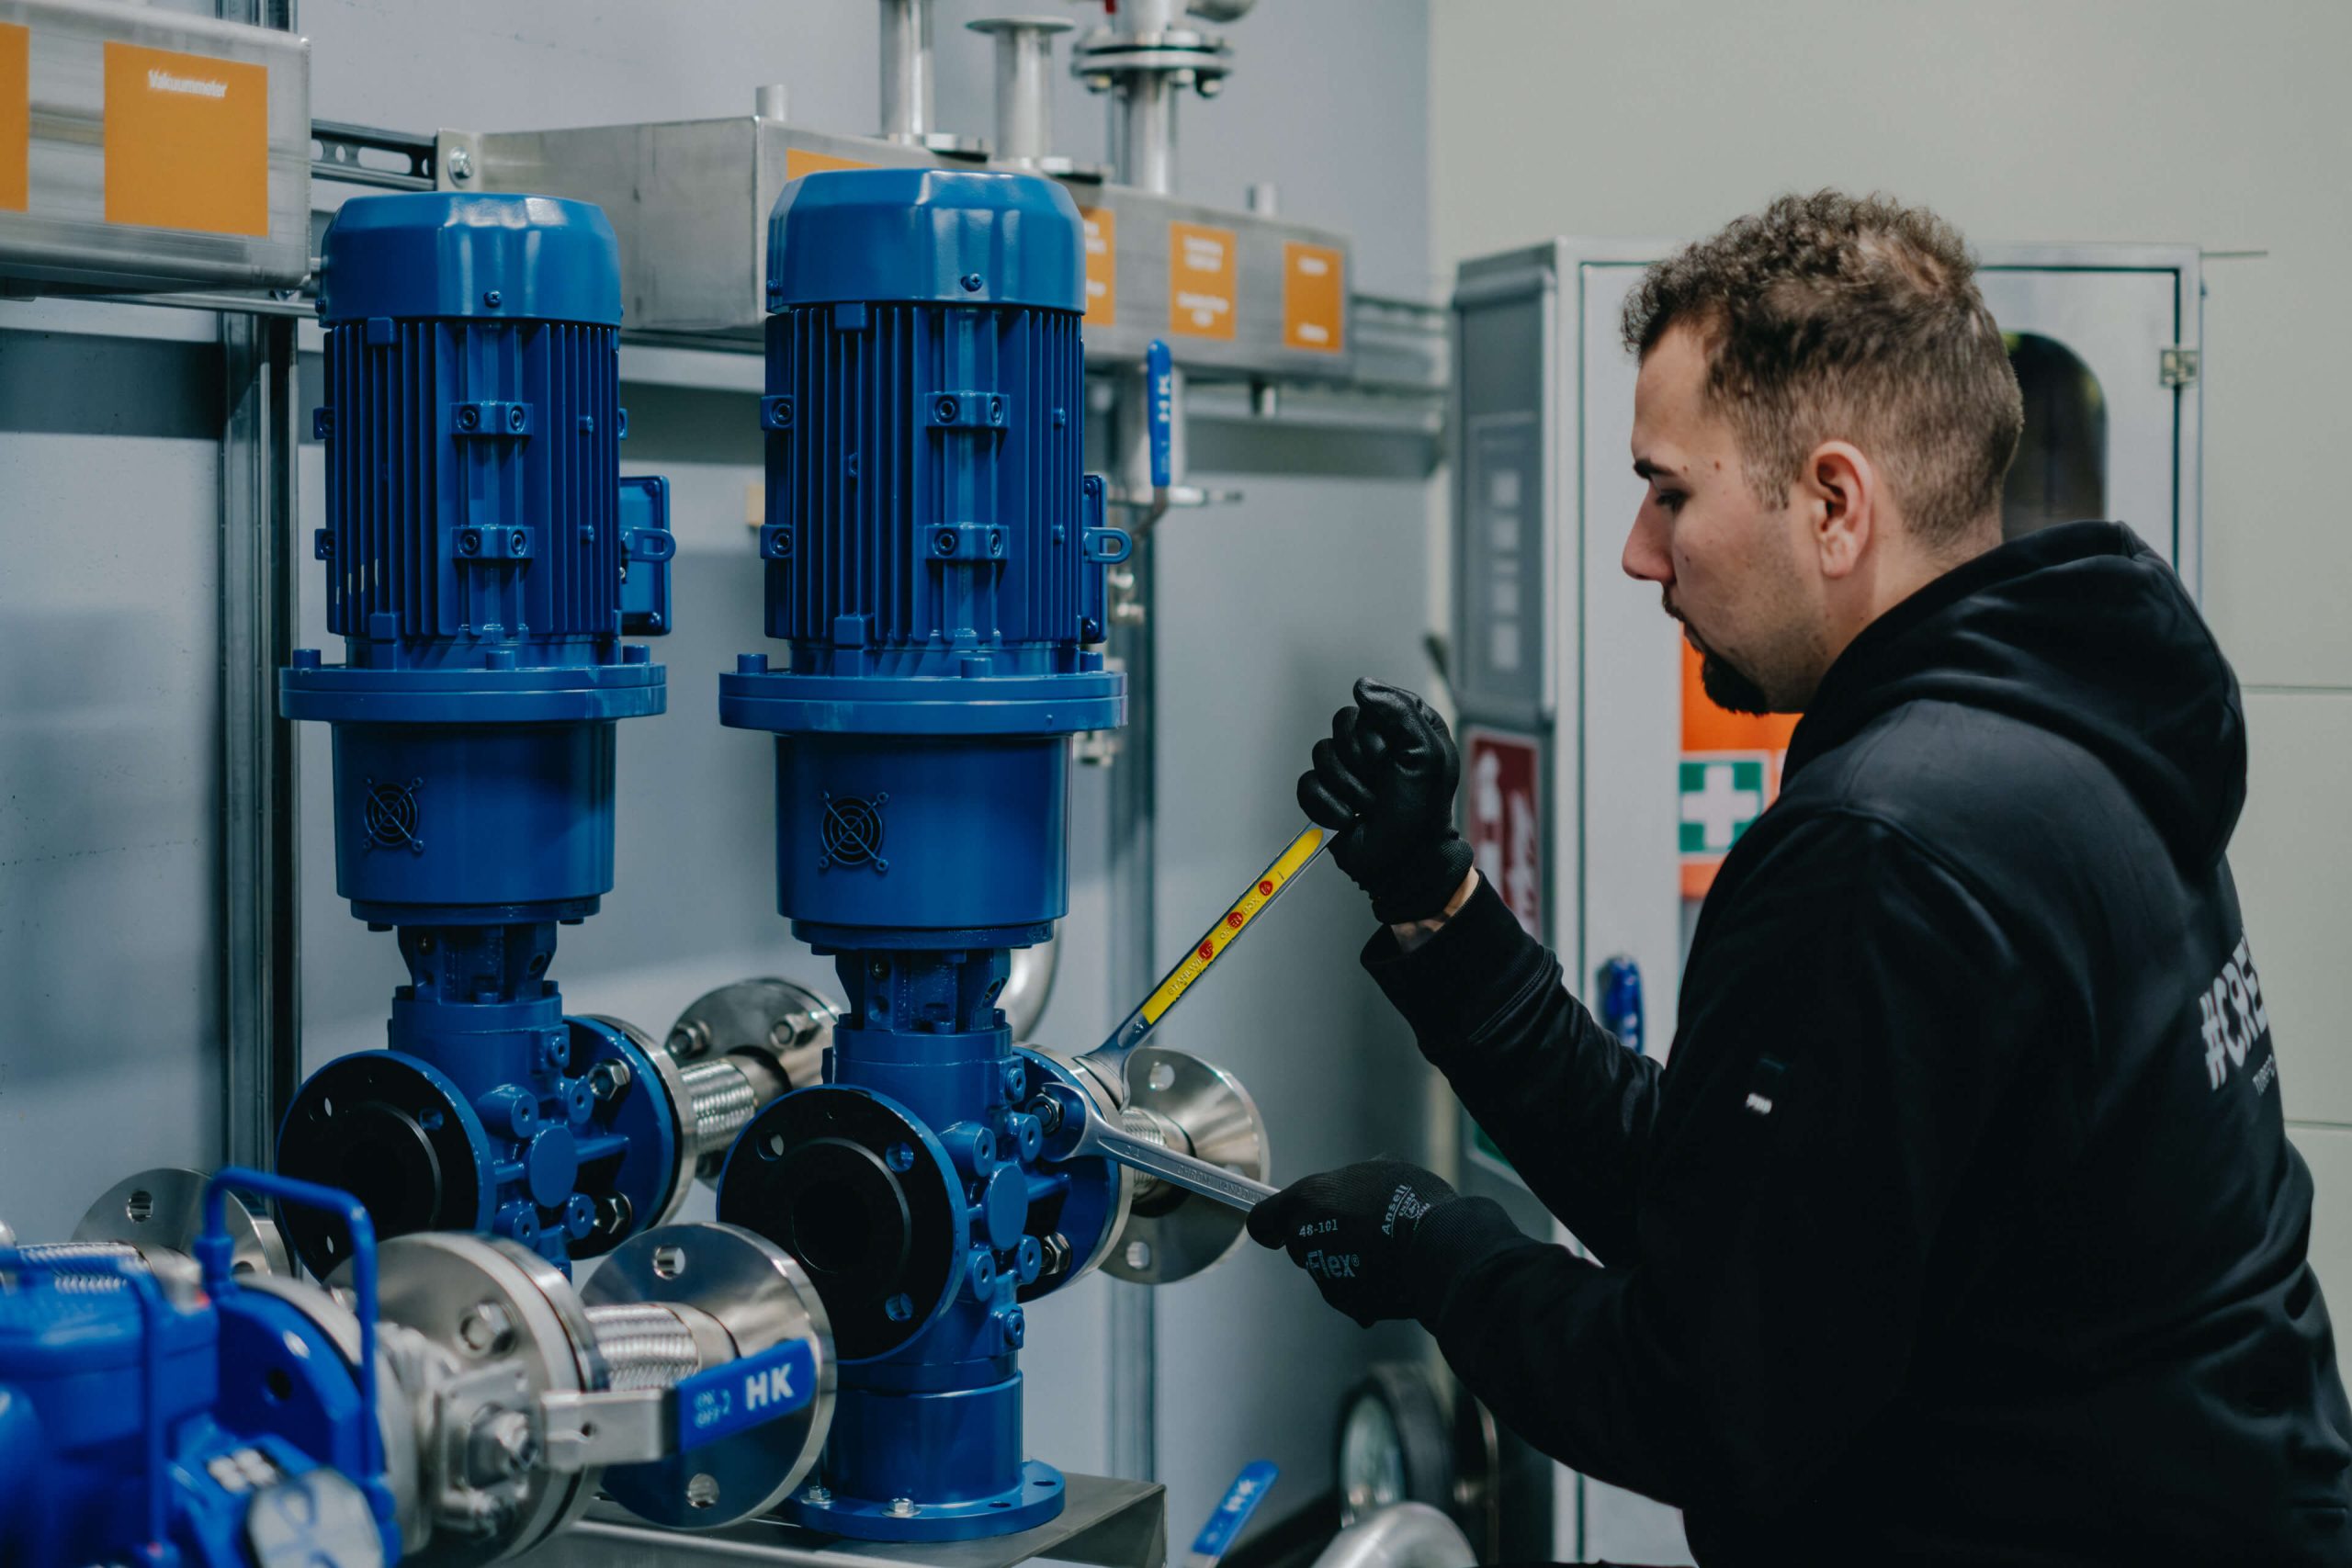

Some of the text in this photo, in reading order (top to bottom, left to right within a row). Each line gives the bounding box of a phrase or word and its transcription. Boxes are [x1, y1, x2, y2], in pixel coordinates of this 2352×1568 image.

[2199, 931, 2268, 1091] #CRE
[1298, 1218, 1339, 1237] 48-101
[1381, 1184, 1409, 1235] Ansell
[745, 1362, 795, 1411] HK
